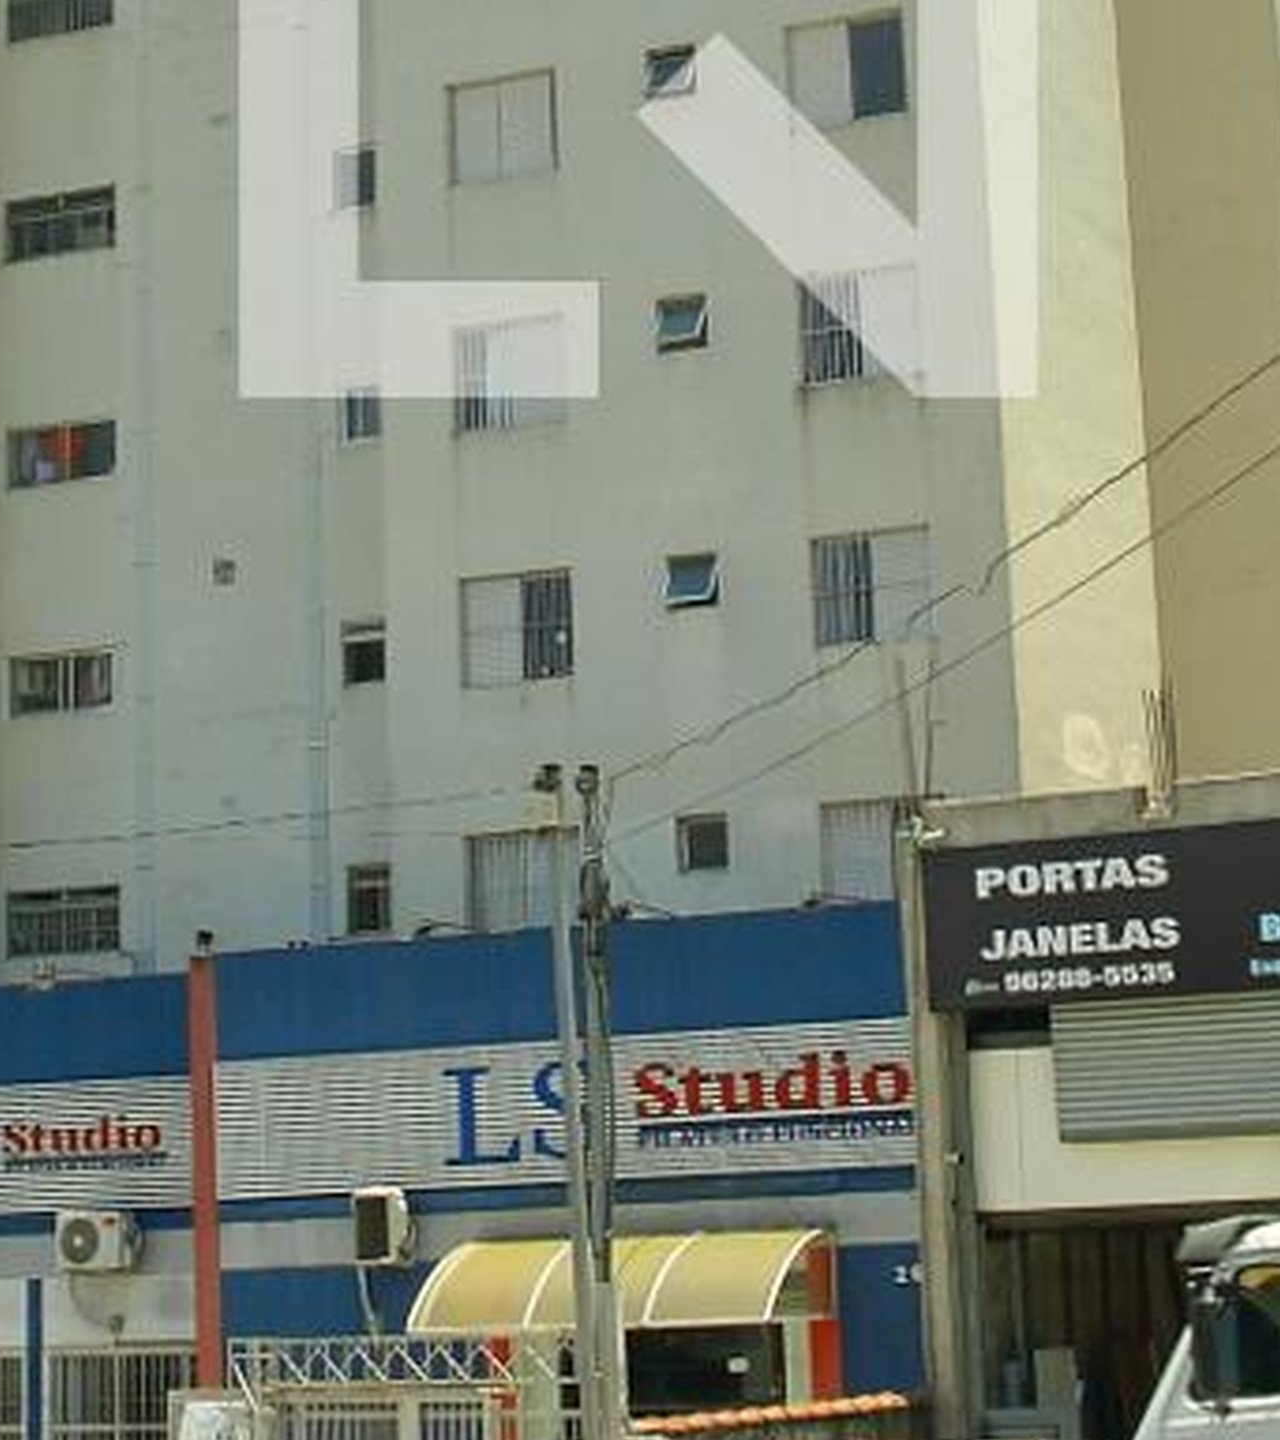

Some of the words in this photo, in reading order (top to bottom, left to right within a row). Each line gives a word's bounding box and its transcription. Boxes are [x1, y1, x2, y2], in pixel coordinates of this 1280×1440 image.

[975, 854, 1169, 899] PORTAS
[980, 917, 1180, 961] JANELAS
[634, 1049, 912, 1118] Studio
[1, 1115, 162, 1154] Studio
